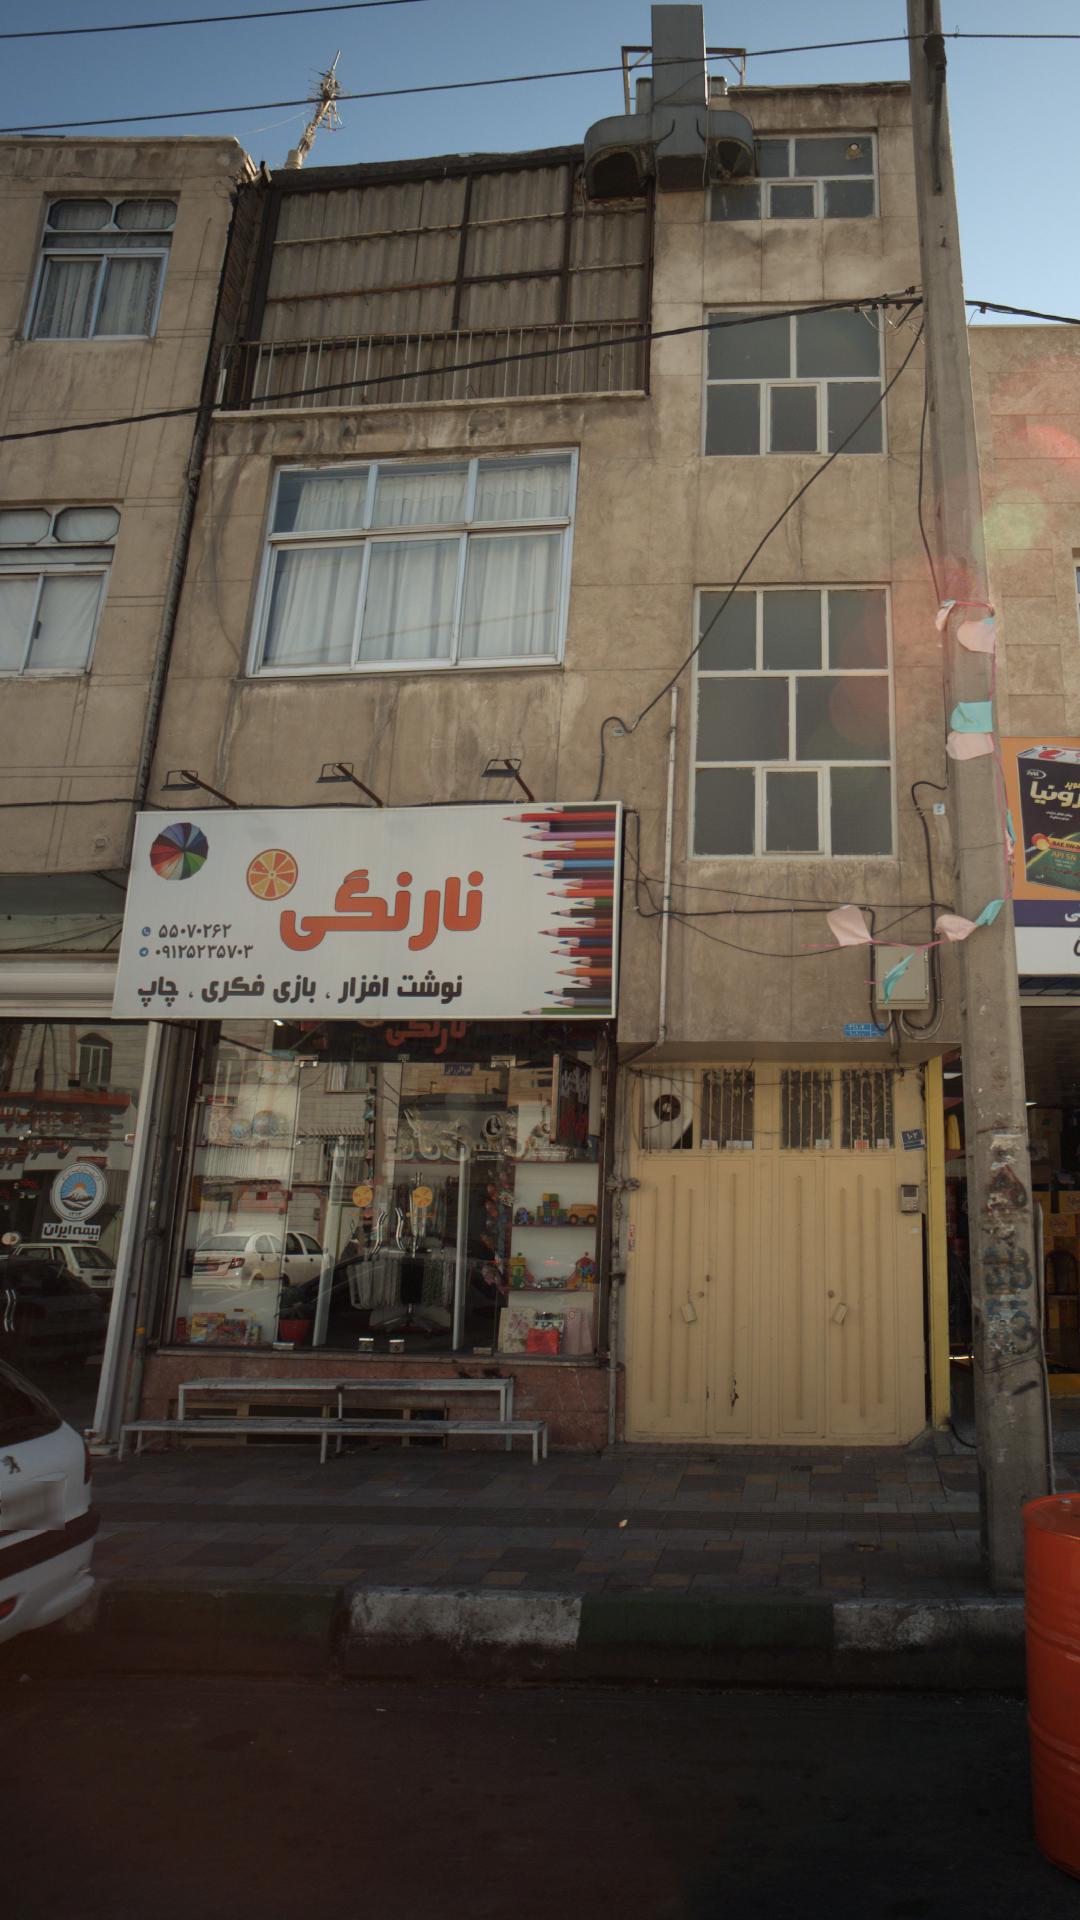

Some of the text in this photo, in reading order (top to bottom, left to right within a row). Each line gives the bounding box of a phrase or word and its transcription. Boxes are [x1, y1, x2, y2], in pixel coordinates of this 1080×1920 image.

[279, 869, 484, 951] نارنگی
[158, 924, 232, 938] ۵۵۰۷۰۲۶۲
[137, 976, 179, 1007] چاپ
[201, 974, 265, 1003] فکری
[273, 974, 316, 1003] بازی
[338, 974, 389, 1004] افزار
[397, 970, 463, 1005] نوشت
[43, 1224, 99, 1239] بیمه ایران
